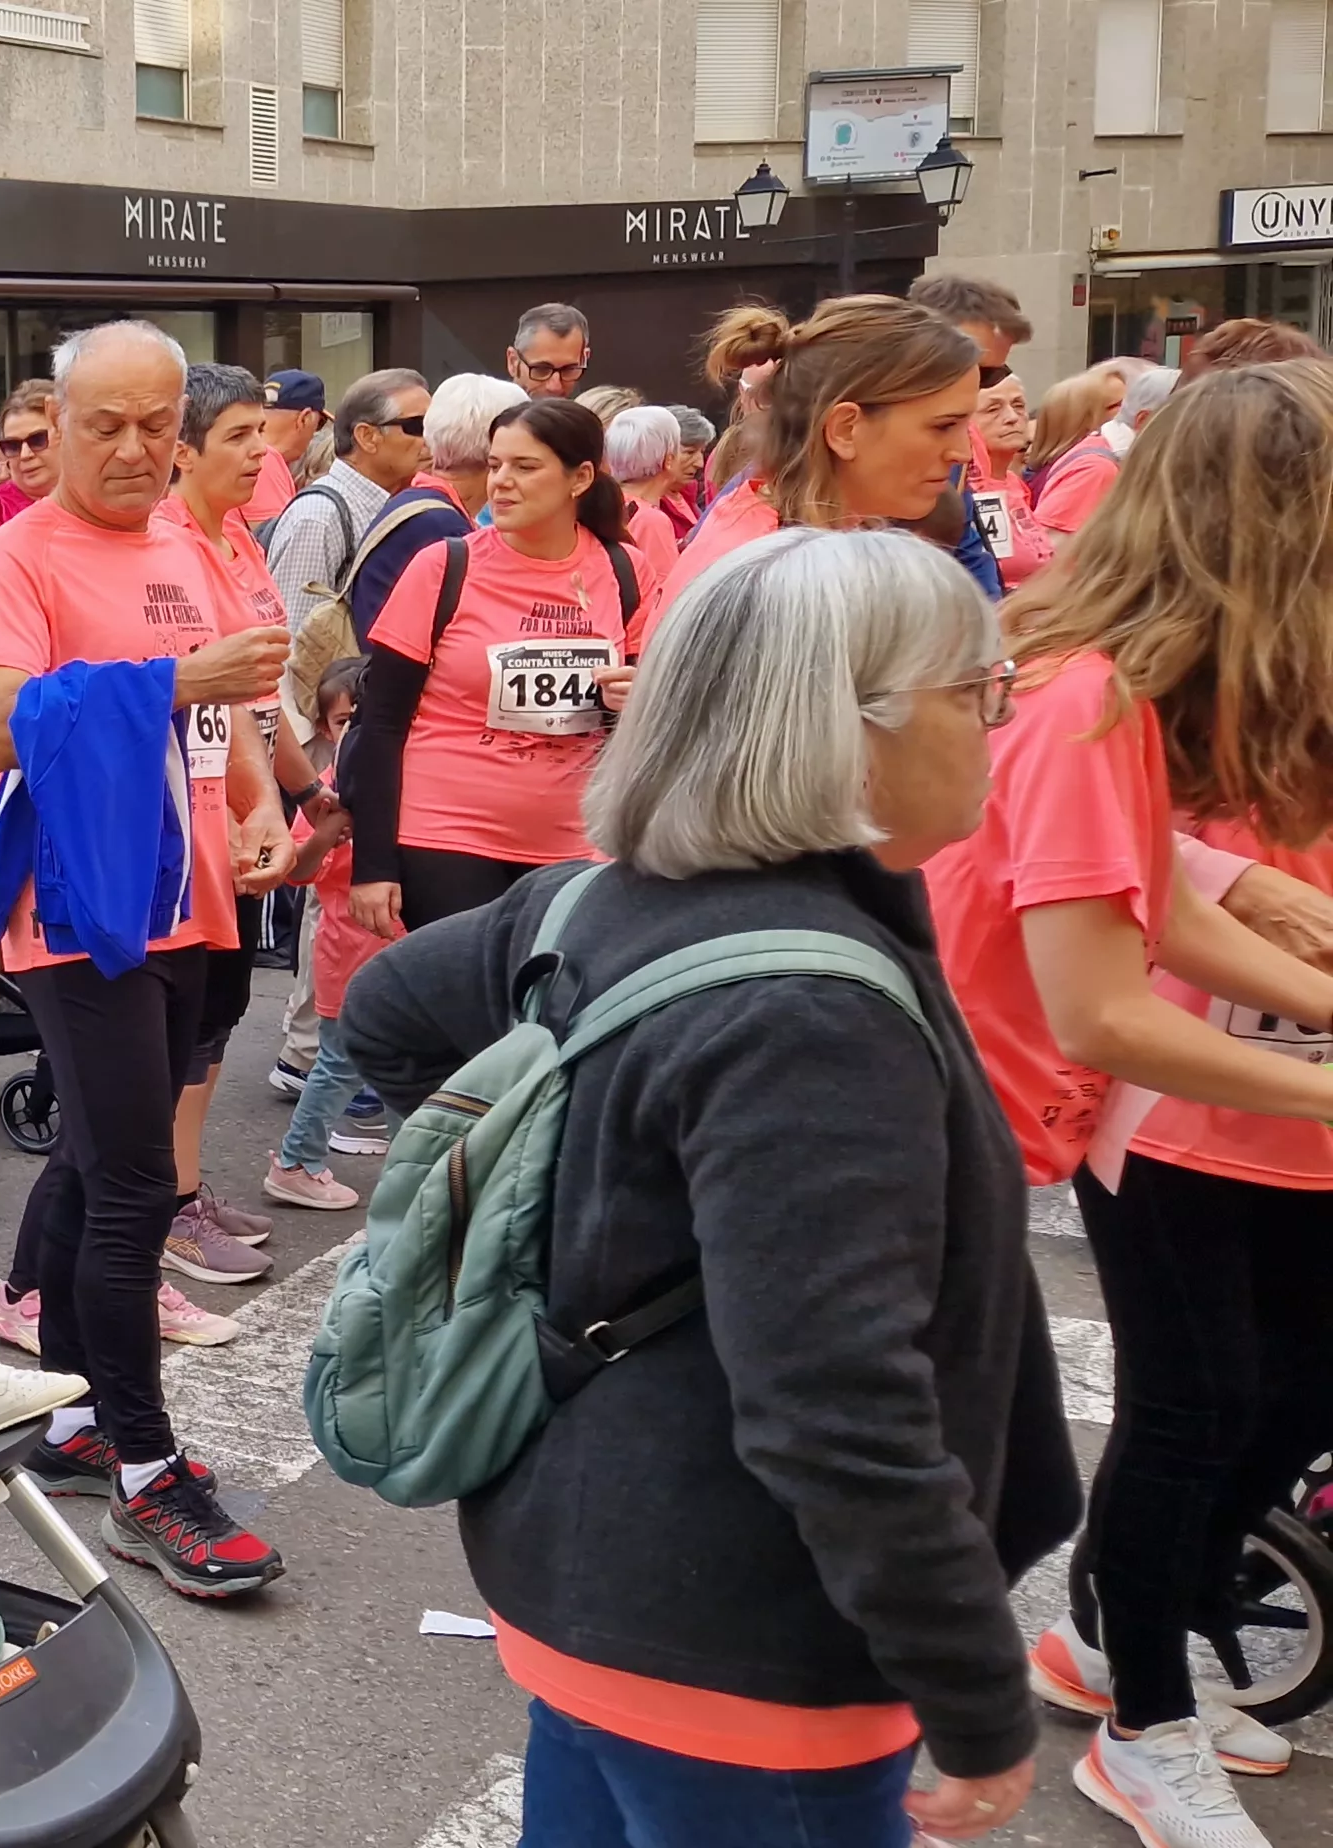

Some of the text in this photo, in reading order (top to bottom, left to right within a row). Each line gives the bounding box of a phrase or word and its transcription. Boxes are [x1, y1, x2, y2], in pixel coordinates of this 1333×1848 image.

[125, 195, 226, 243] MIRATE
[1261, 197, 1333, 229] UNY
[148, 255, 206, 268] MENSWEAR
[653, 251, 724, 264] MENSWEAR
[143, 605, 162, 625] POR
[172, 605, 203, 624] CIENCIA
[531, 602, 583, 621] CORRAMOS
[519, 616, 593, 635] POR LA CIENCIA
[507, 656, 605, 668] CONTRA EL CÁNCER
[542, 650, 573, 658] HUESCA
[507, 673, 601, 707] 1844
[152, 1473, 177, 1491] FILA
